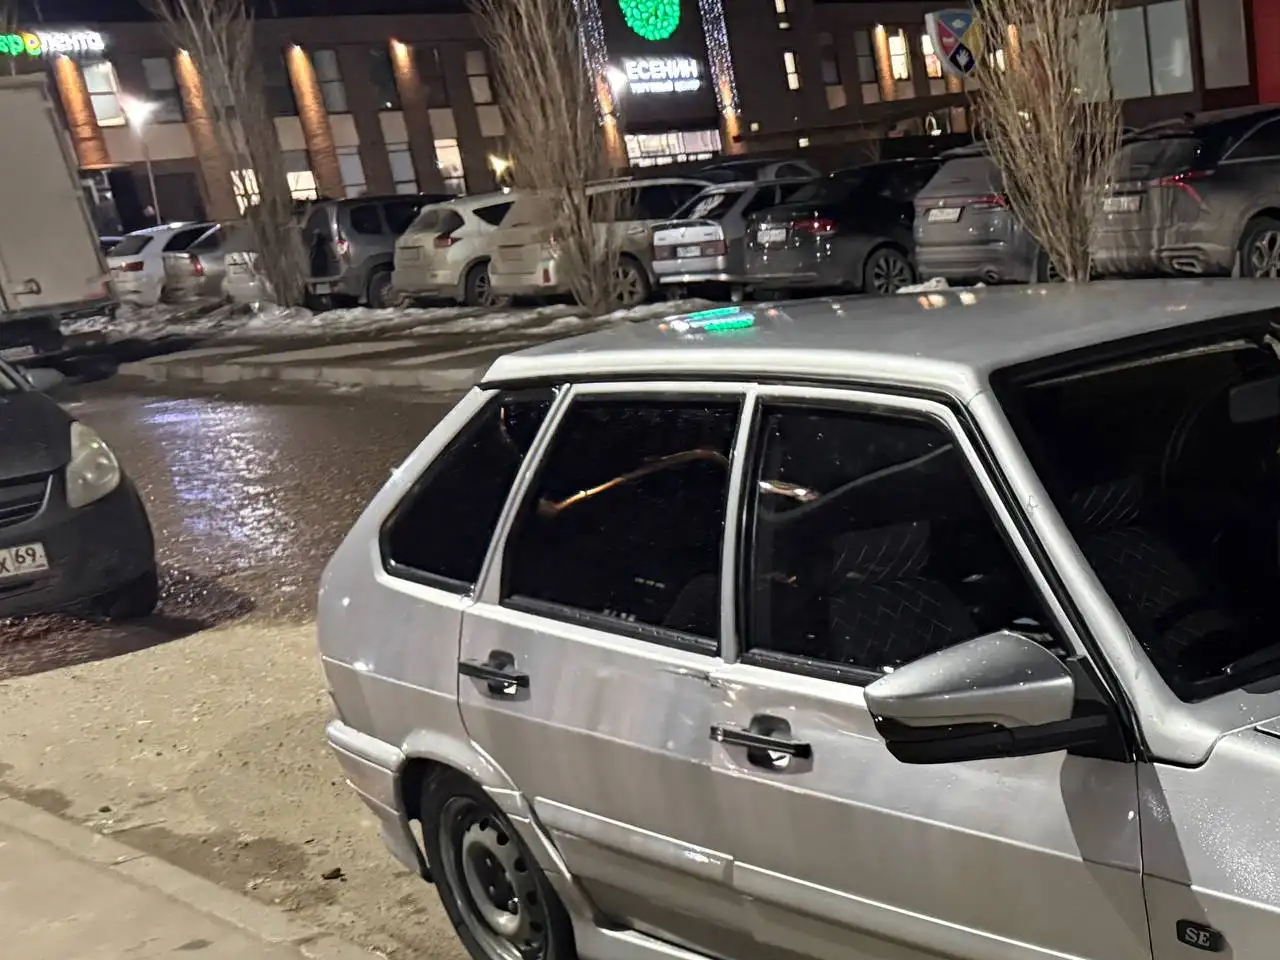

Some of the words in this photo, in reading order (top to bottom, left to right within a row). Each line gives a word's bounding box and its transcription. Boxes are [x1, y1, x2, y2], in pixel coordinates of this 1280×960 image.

[625, 59, 698, 80] ЕСЕНИН
[15, 547, 37, 564] 69
[1184, 927, 1210, 947] SE
